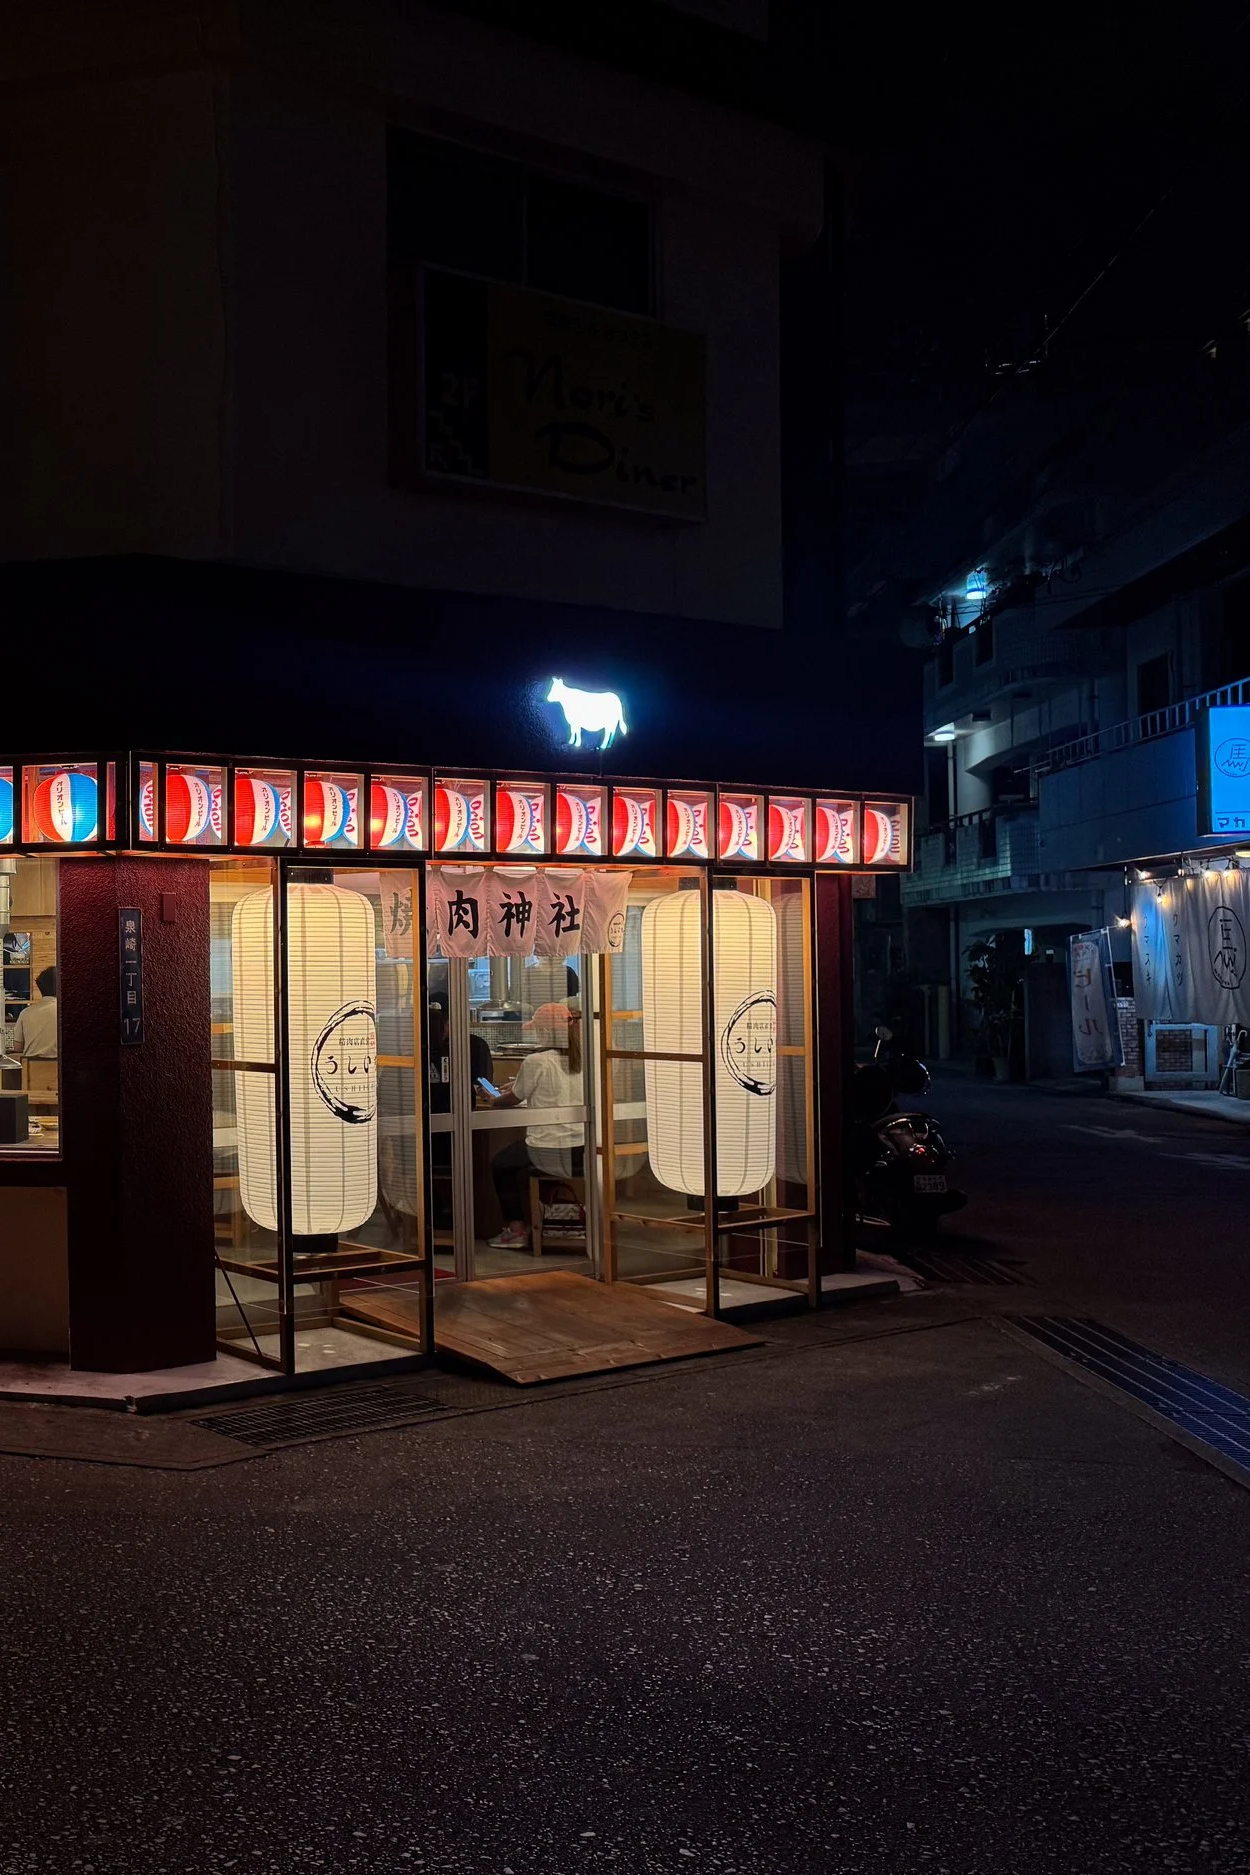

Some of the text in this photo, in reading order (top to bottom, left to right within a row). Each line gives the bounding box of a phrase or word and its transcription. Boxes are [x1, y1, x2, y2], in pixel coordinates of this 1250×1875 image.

[496, 348, 656, 423] Nori's
[533, 421, 697, 495] Diner
[56, 781, 68, 826] オリオンビール
[193, 782, 204, 827] オリオンビール
[261, 787, 270, 832] オリオンビール
[328, 787, 338, 827] オリオンビール
[392, 793, 402, 833] オリオンビール
[454, 797, 463, 837] オリオンビール
[470, 800, 484, 840] Orion
[517, 799, 526, 839] オリオンビール
[123, 919, 141, 1036] 泉崎一丁目 17
